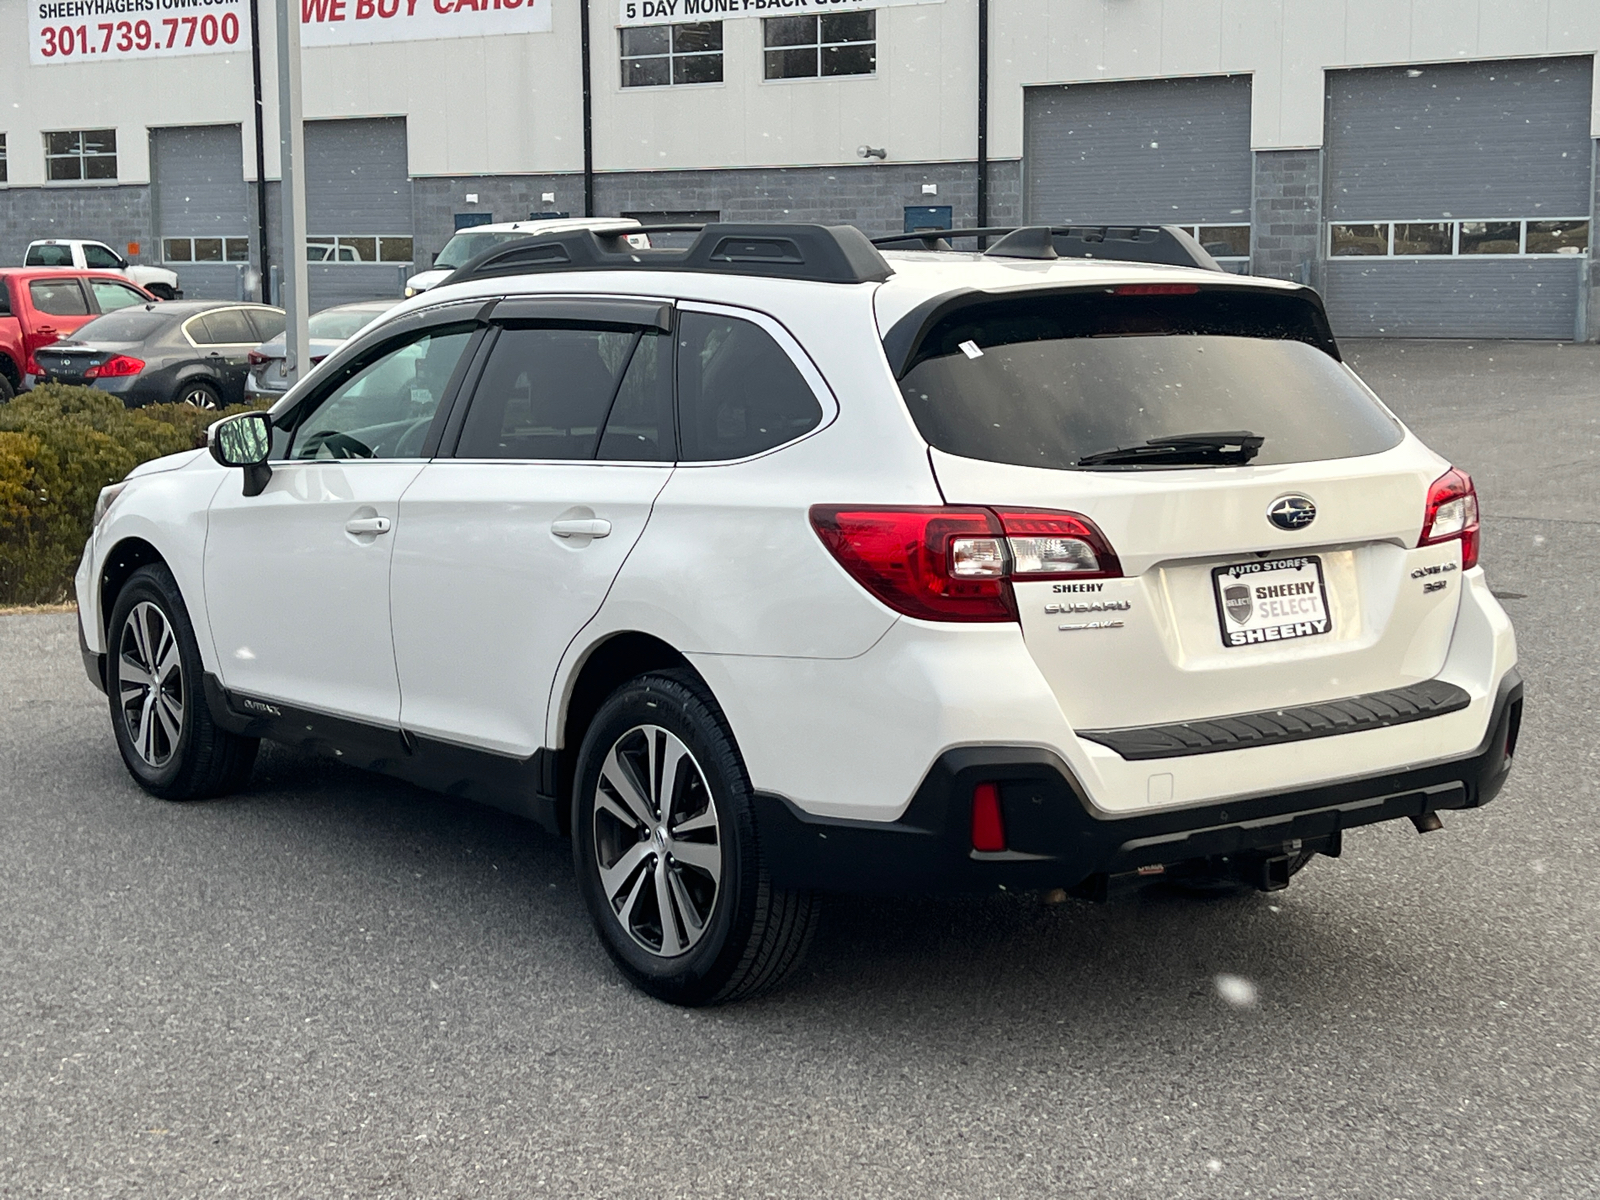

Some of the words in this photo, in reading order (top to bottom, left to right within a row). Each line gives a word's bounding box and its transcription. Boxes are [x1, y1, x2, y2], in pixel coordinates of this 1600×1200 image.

[39, 0, 238, 19] SHEEHYHAGERSTOW.
[626, 3, 636, 19] 5
[643, 0, 678, 18] DAY
[40, 12, 239, 57] 301.739.7700
[1228, 564, 1261, 576] AUTO
[1263, 558, 1308, 571] STORES
[1052, 583, 1104, 593] SHEEHY
[1255, 581, 1315, 599] SHEEHY
[1044, 600, 1131, 614] SUBARU
[1259, 597, 1318, 618] SELECT
[1230, 620, 1328, 645] SHEEHY
